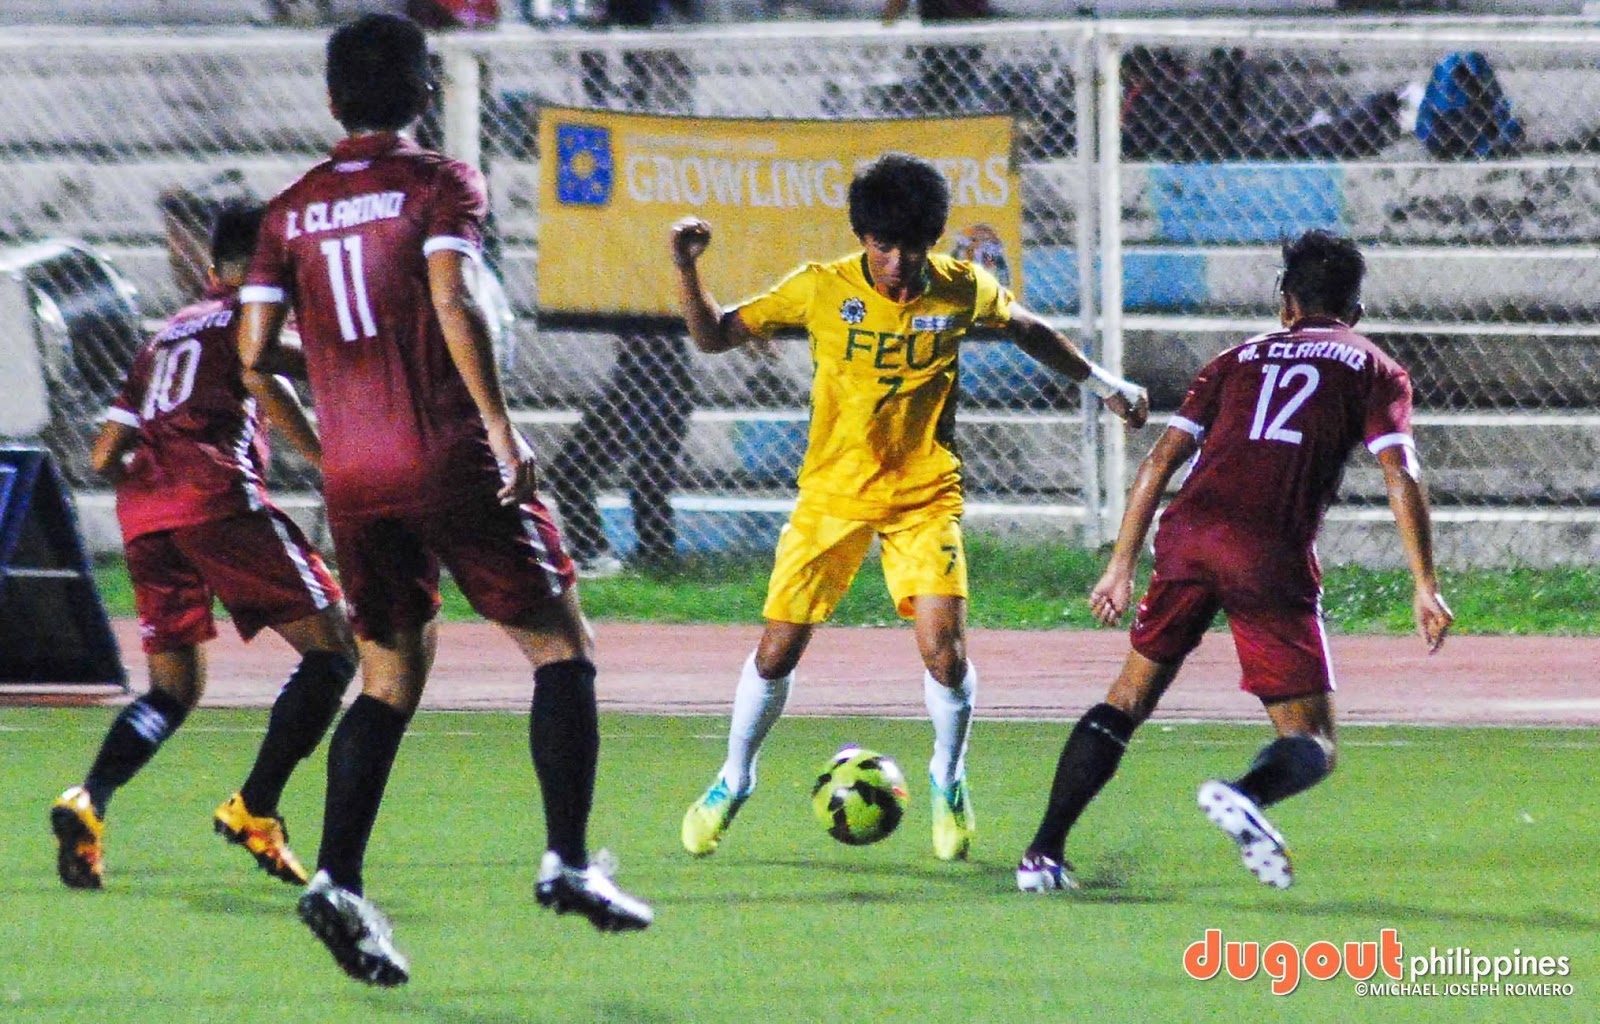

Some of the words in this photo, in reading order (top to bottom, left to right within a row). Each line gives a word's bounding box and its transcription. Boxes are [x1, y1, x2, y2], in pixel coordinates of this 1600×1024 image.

[625, 153, 848, 209] GROWLING
[320, 235, 378, 342] 11
[845, 328, 940, 370] FEU
[1238, 344, 1260, 363] M.
[1268, 341, 1367, 371] CLARINO
[142, 338, 202, 420] 10
[873, 376, 904, 415] 7
[1249, 364, 1320, 445] 12
[941, 545, 957, 576] 7
